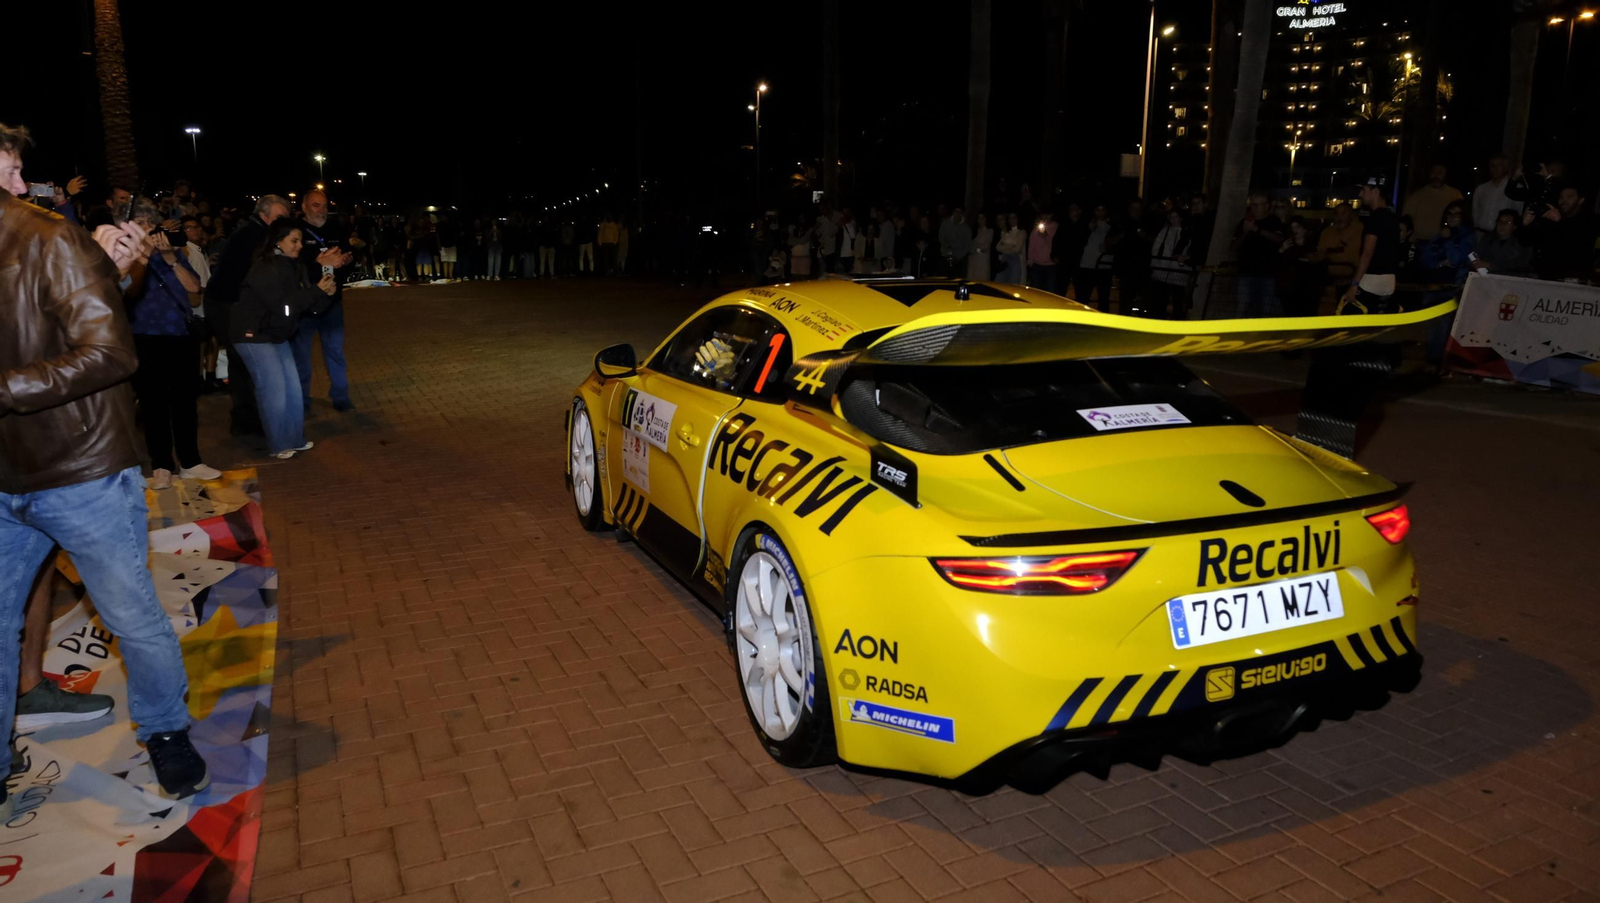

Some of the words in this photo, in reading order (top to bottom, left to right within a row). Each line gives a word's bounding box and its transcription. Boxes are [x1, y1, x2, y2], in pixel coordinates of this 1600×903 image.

[1276, 7, 1306, 17] GRAN
[1312, 3, 1347, 15] HOTEL
[769, 297, 801, 313] AON
[1529, 313, 1569, 326] CIUDAD
[754, 333, 785, 393] 1
[625, 393, 634, 426] 1
[709, 412, 878, 536] Recalvi
[877, 461, 908, 481] TRS
[765, 539, 799, 591] MICHELIN
[1197, 520, 1341, 587] Recalvi
[1177, 627, 1185, 639] E
[1191, 590, 1270, 636] 7671
[1280, 578, 1331, 621] MZY
[833, 628, 898, 664] AON
[866, 675, 928, 703] RADSA
[872, 711, 941, 733] MICHELIN
